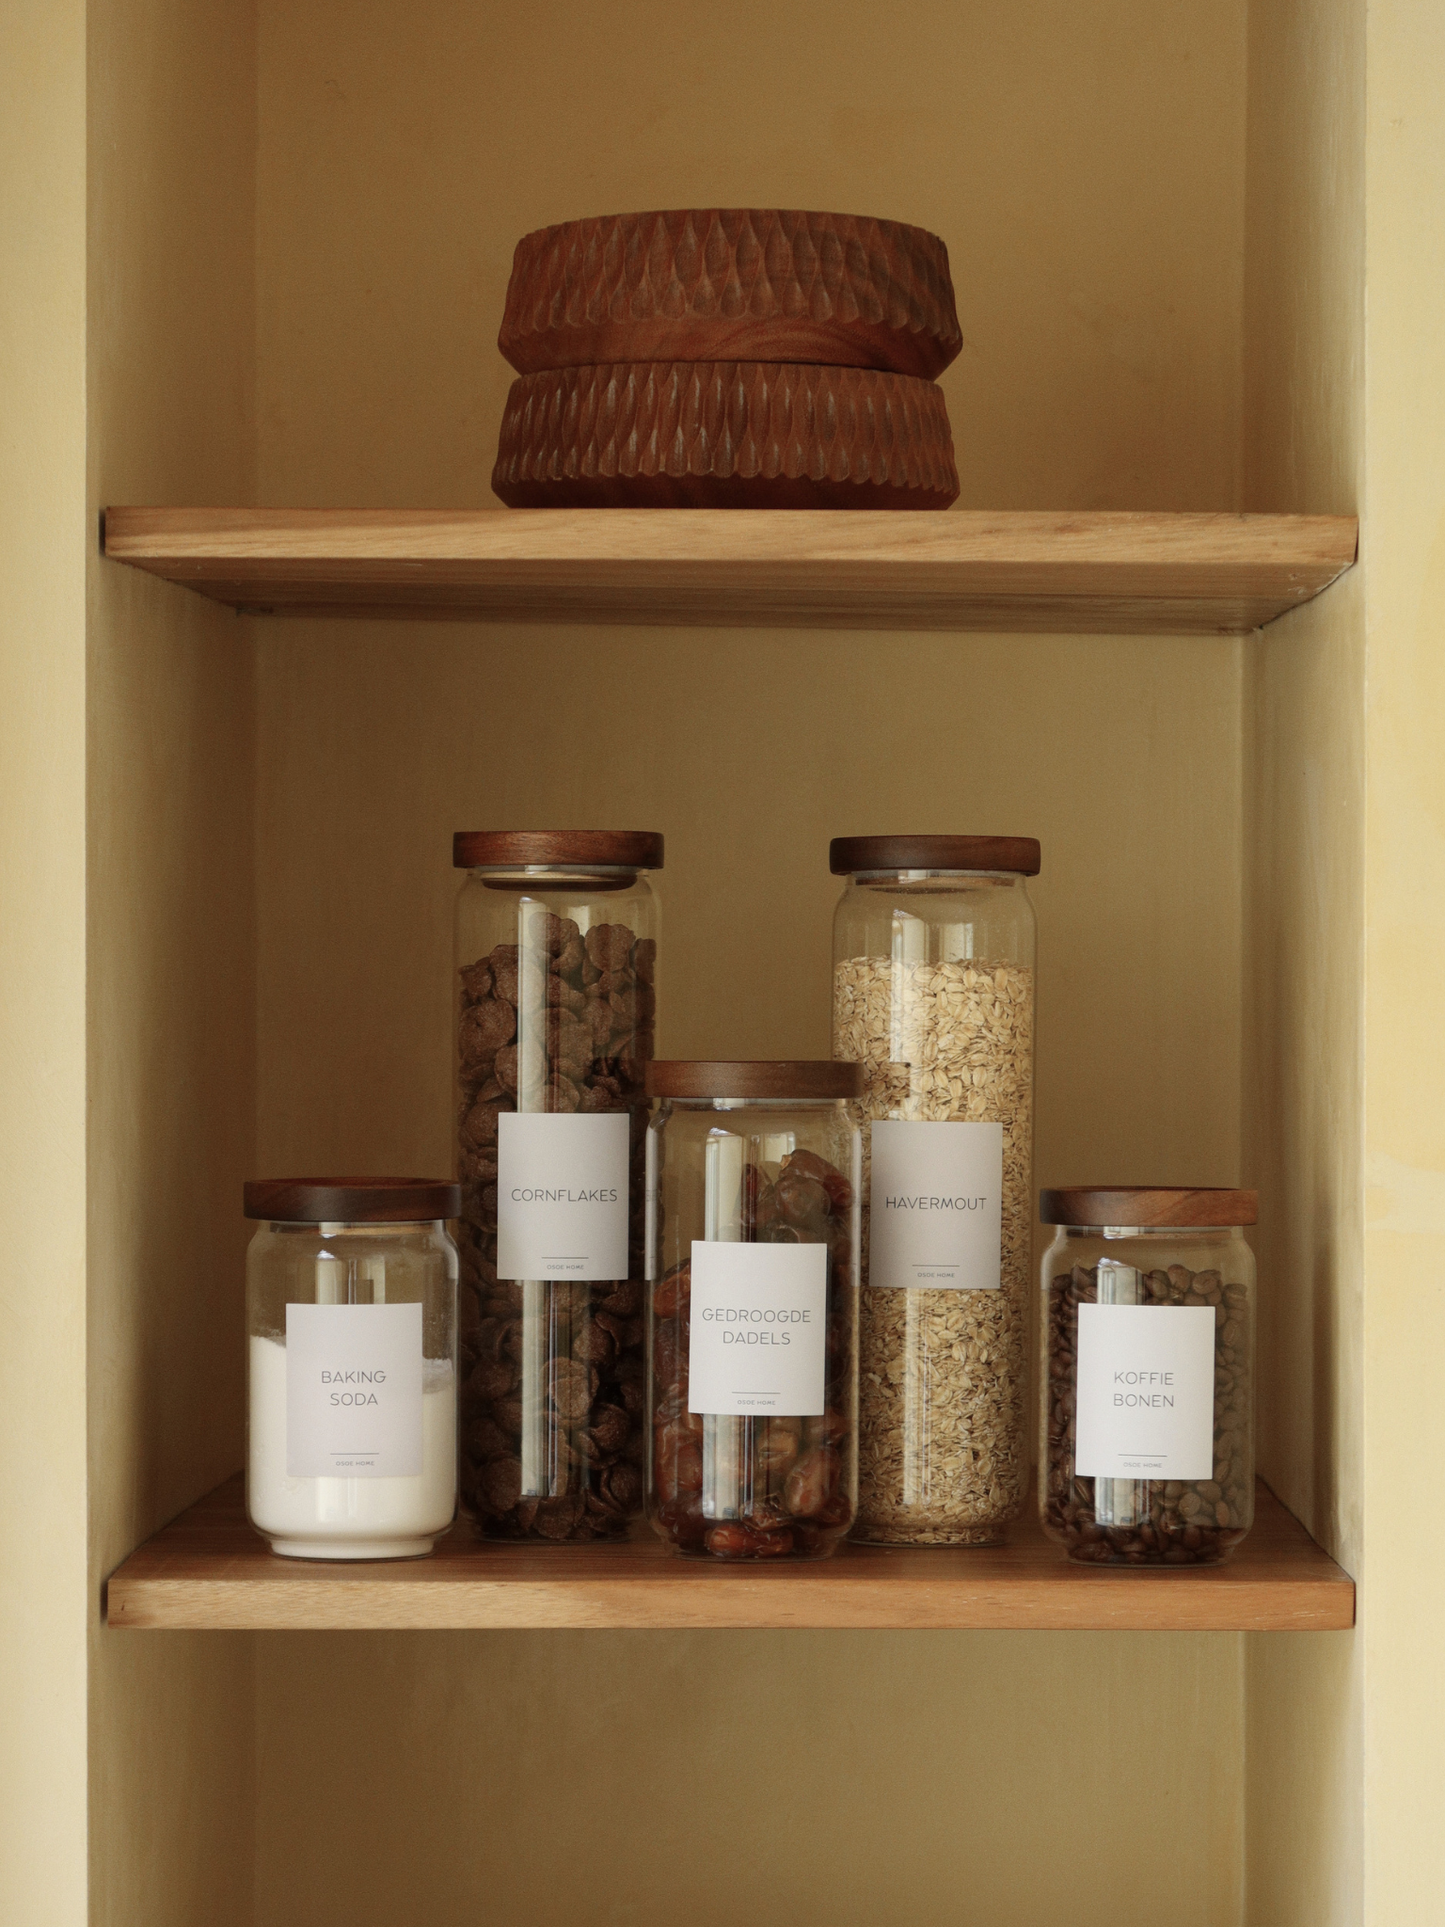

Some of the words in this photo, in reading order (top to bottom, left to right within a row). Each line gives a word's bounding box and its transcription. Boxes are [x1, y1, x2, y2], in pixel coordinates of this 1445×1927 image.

[511, 1188, 618, 1203] CORNFLAKES
[885, 1196, 987, 1211] HAVERMOUT
[701, 1307, 811, 1323] GEDROOGDE
[722, 1330, 791, 1346] DADELS
[321, 1370, 387, 1384] BAKING
[1114, 1371, 1174, 1386] KOFFIE
[330, 1392, 379, 1407] SODA
[1113, 1393, 1175, 1408] BONEN
